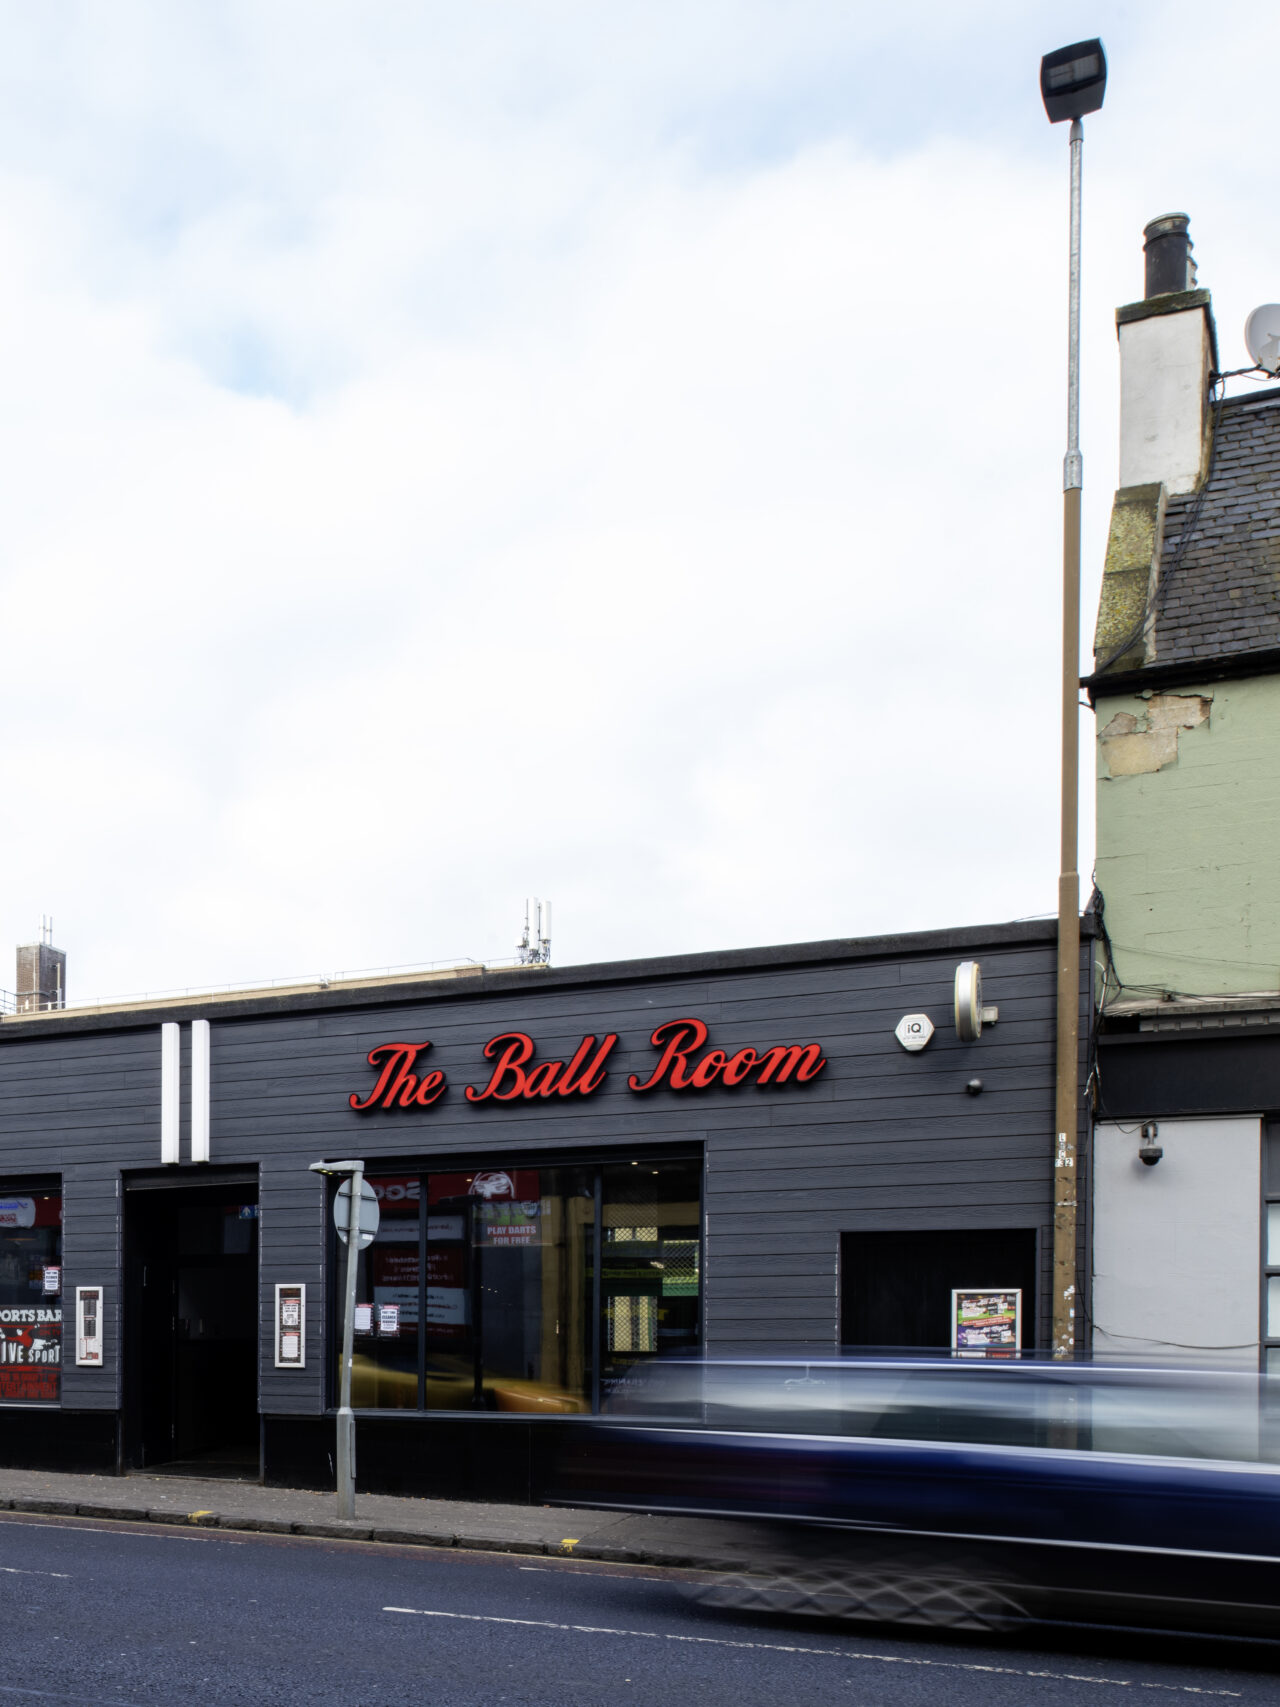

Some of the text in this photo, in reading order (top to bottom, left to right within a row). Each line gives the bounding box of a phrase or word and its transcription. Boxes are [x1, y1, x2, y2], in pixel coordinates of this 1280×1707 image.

[907, 1023, 921, 1033] iQ
[349, 1018, 827, 1111] The Ball Room
[487, 1225, 536, 1234] PLAY DARTS
[511, 1236, 530, 1244] FREE
[28, 1345, 60, 1363] SPORT
